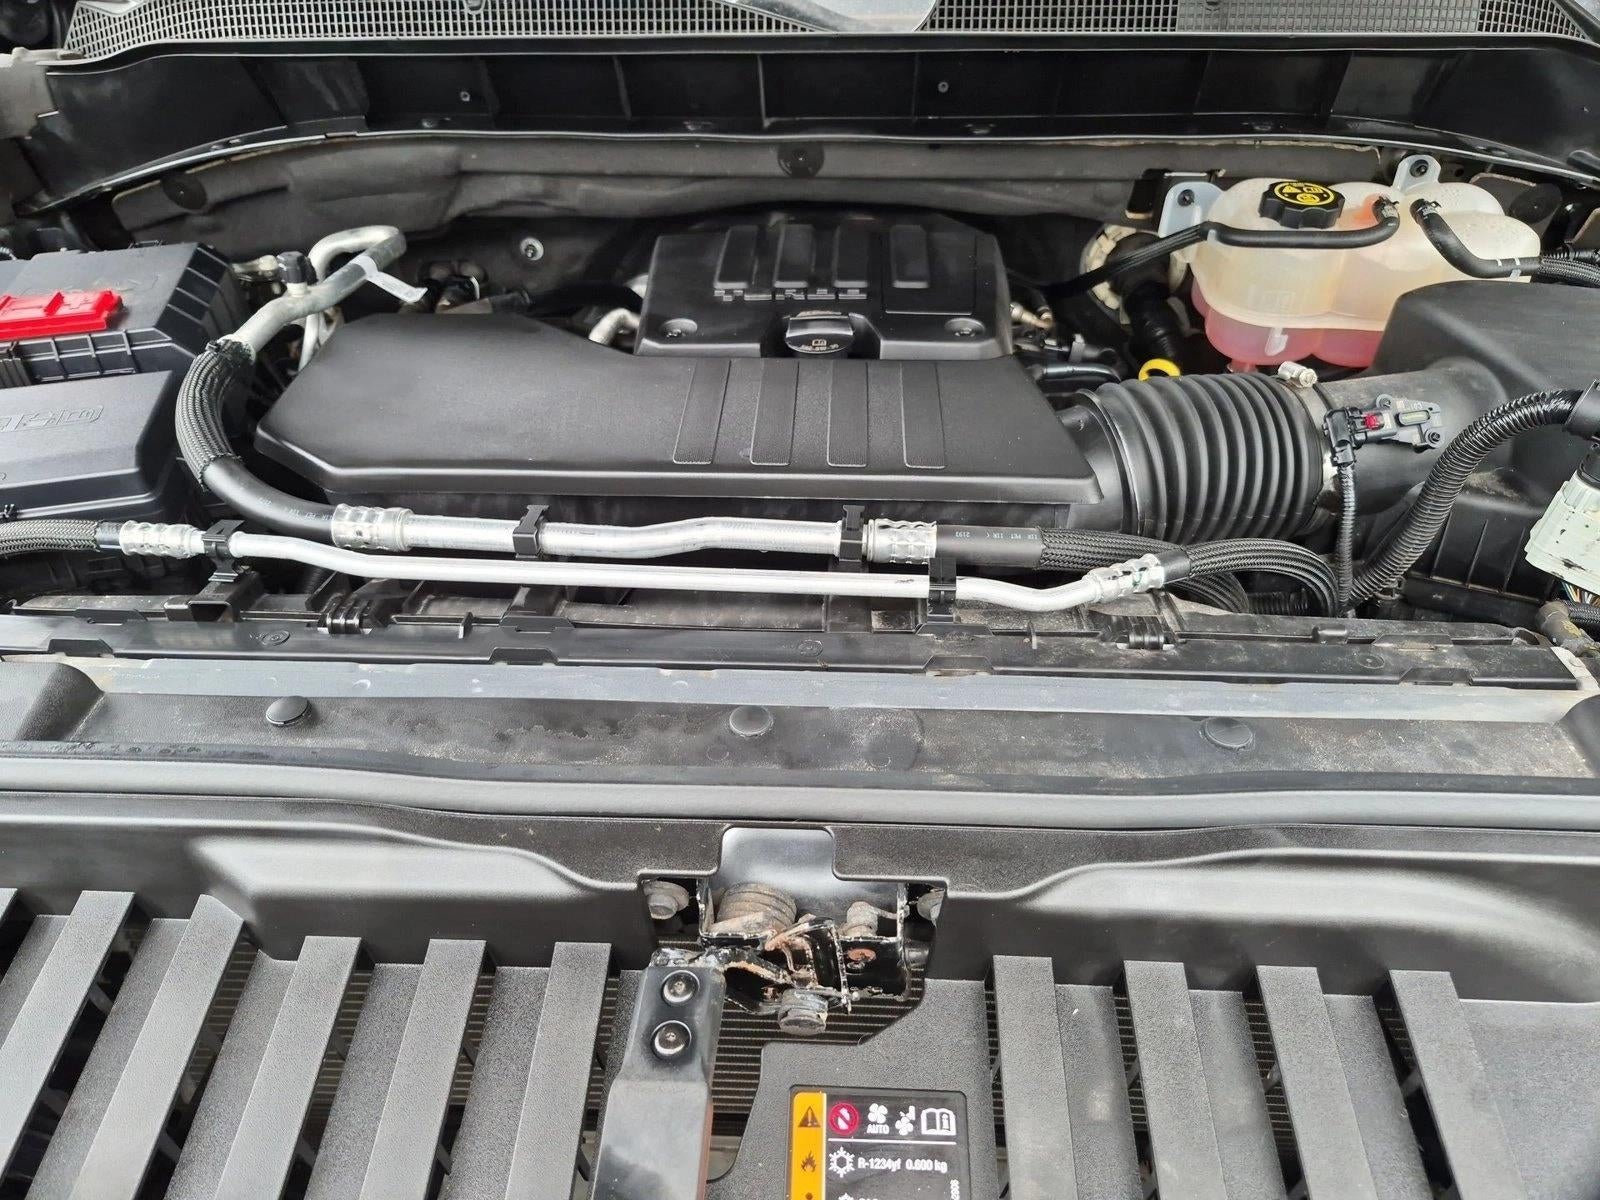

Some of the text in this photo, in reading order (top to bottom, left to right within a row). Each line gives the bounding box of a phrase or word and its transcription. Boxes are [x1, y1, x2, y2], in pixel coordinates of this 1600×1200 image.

[866, 1123, 890, 1135] AUTO
[857, 1156, 902, 1172] R-1234yf
[934, 1158, 948, 1174] kg
